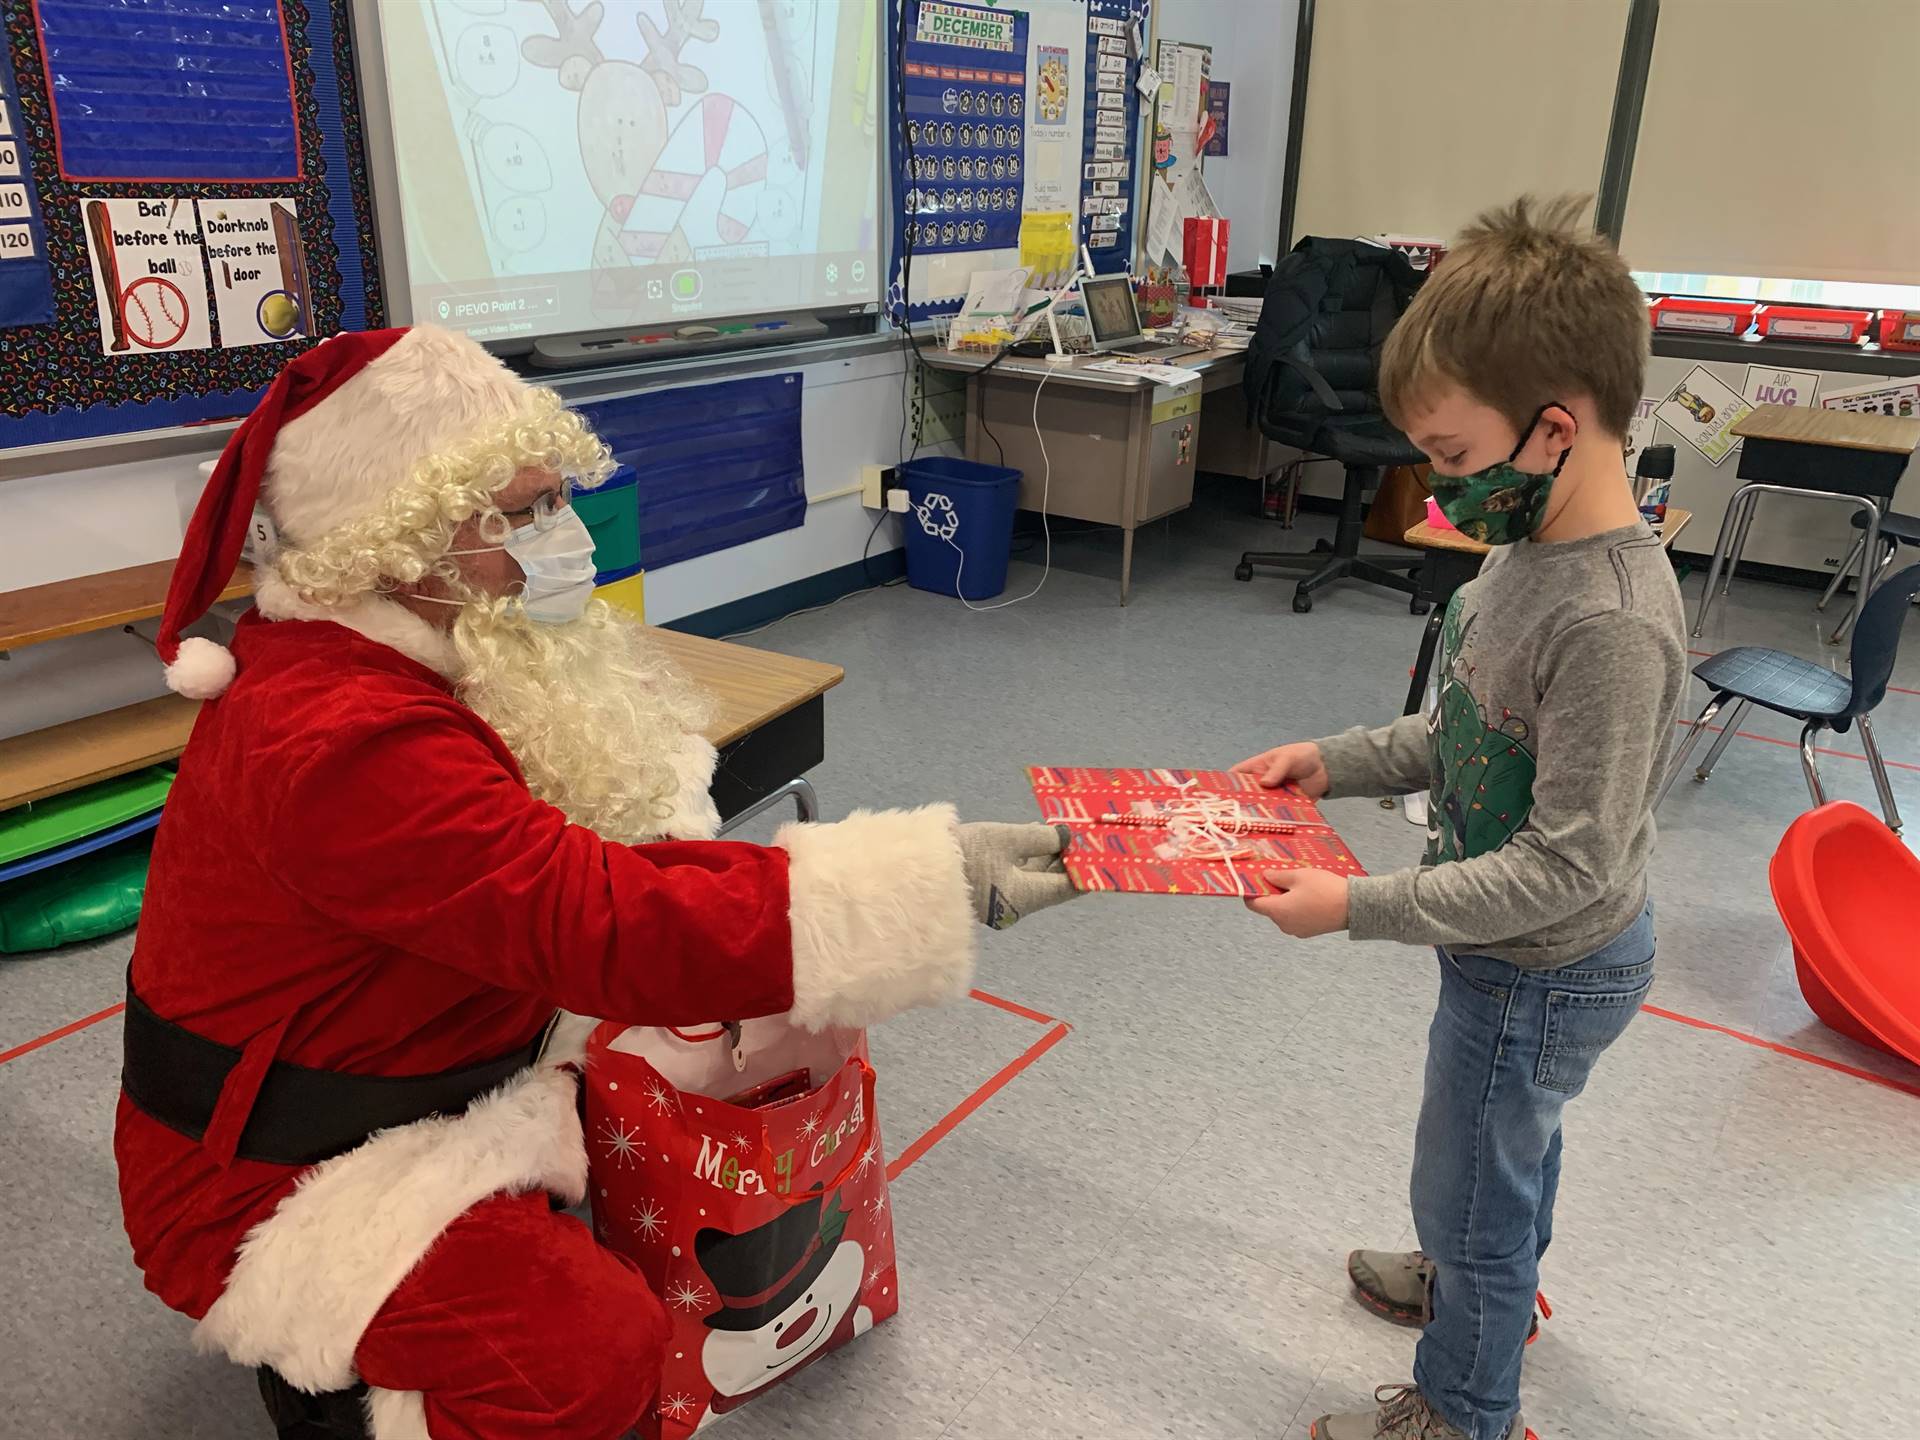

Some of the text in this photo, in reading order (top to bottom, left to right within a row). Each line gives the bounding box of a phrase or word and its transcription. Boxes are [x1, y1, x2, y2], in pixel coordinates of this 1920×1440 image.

[933, 15, 1003, 40] DECEMBER
[1013, 99, 1019, 114] 5
[910, 126, 1019, 145] 6 7 8 9 10 11 12
[946, 161, 953, 176] 15
[962, 161, 970, 177] 16
[978, 161, 986, 177] 17
[1011, 159, 1018, 173] 19
[138, 201, 167, 217] Bat
[207, 218, 269, 234] Doorknob
[1, 232, 29, 248] 120
[114, 230, 201, 247] before the
[208, 242, 277, 259] before the
[148, 258, 177, 275] ball
[233, 268, 261, 282] door
[455, 301, 488, 317] IPEVO
[491, 299, 518, 313] Point
[518, 298, 526, 311] 2
[1773, 373, 1792, 387] AIR
[1755, 384, 1797, 407] HUG
[1855, 394, 1870, 402] Class
[1871, 389, 1900, 399] Greetings
[1720, 399, 1744, 421] YOUR
[1695, 417, 1726, 448] FRIENDS
[256, 523, 267, 542] 5
[693, 1133, 797, 1195] Merry
